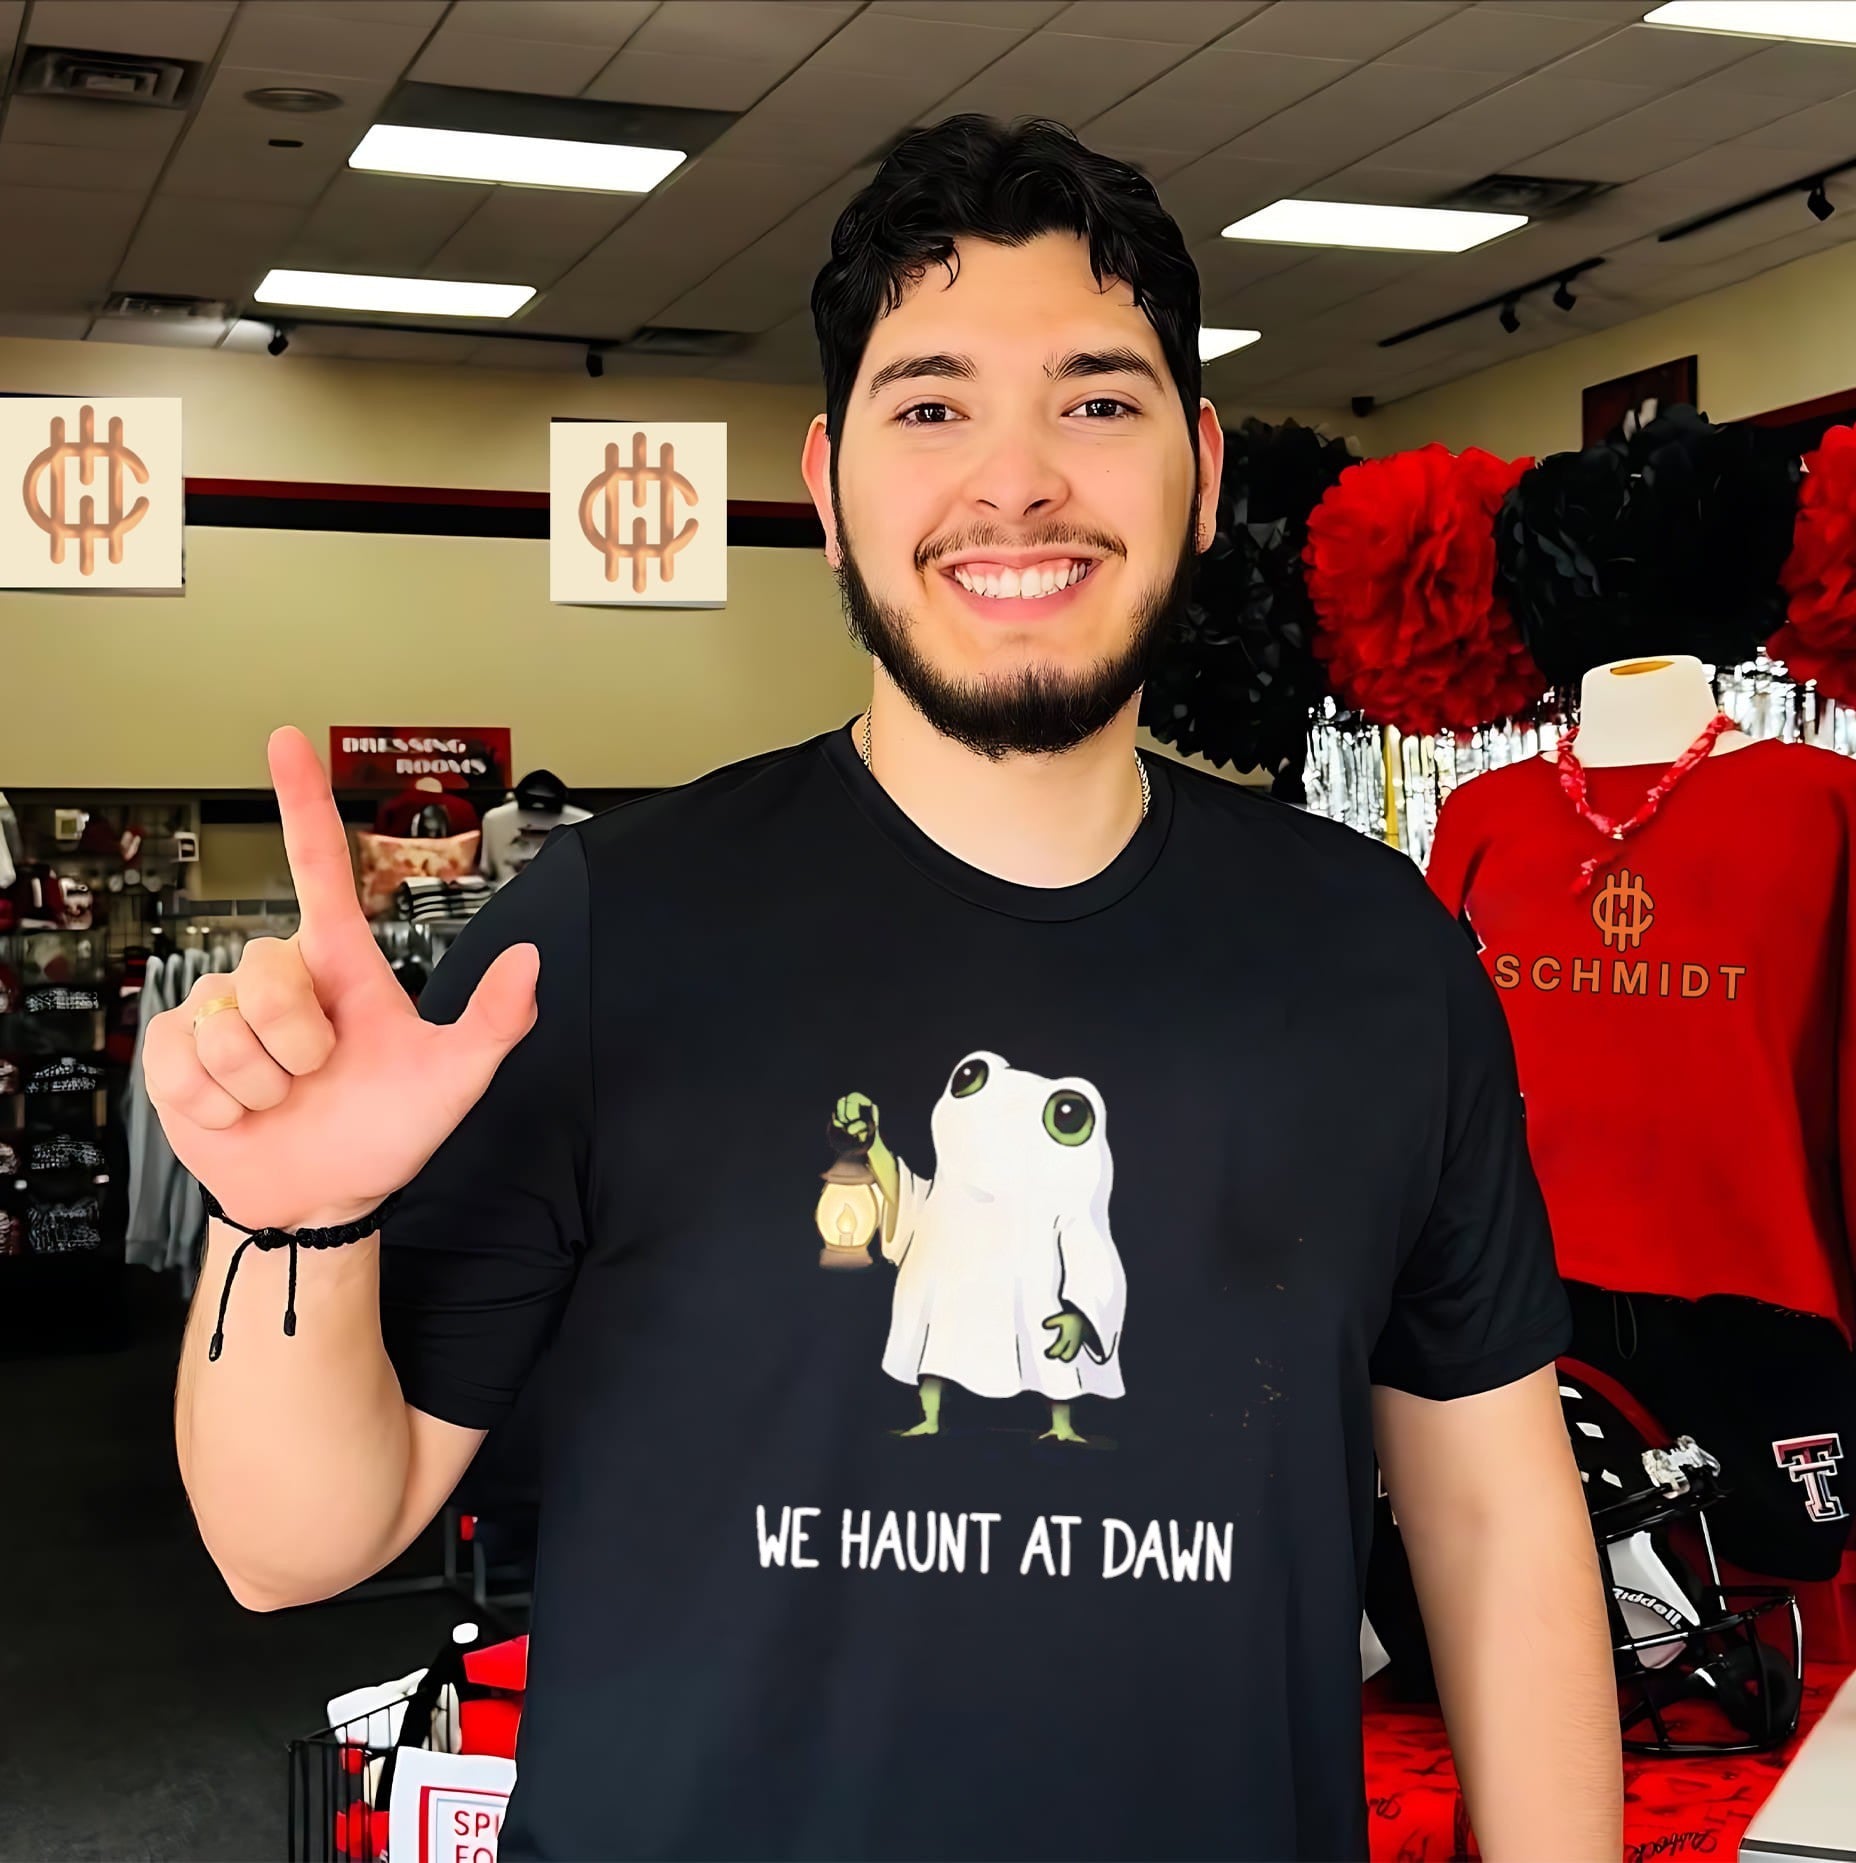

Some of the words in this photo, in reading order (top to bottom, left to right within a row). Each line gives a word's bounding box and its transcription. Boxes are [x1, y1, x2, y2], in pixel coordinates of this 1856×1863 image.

[395, 757, 487, 775] ROOMS
[1493, 953, 1748, 1001] SCHMIDT
[756, 1504, 822, 1569] WE
[841, 1508, 1002, 1574] HAUNT
[1019, 1514, 1082, 1578] AT
[1102, 1517, 1235, 1583] DAWN
